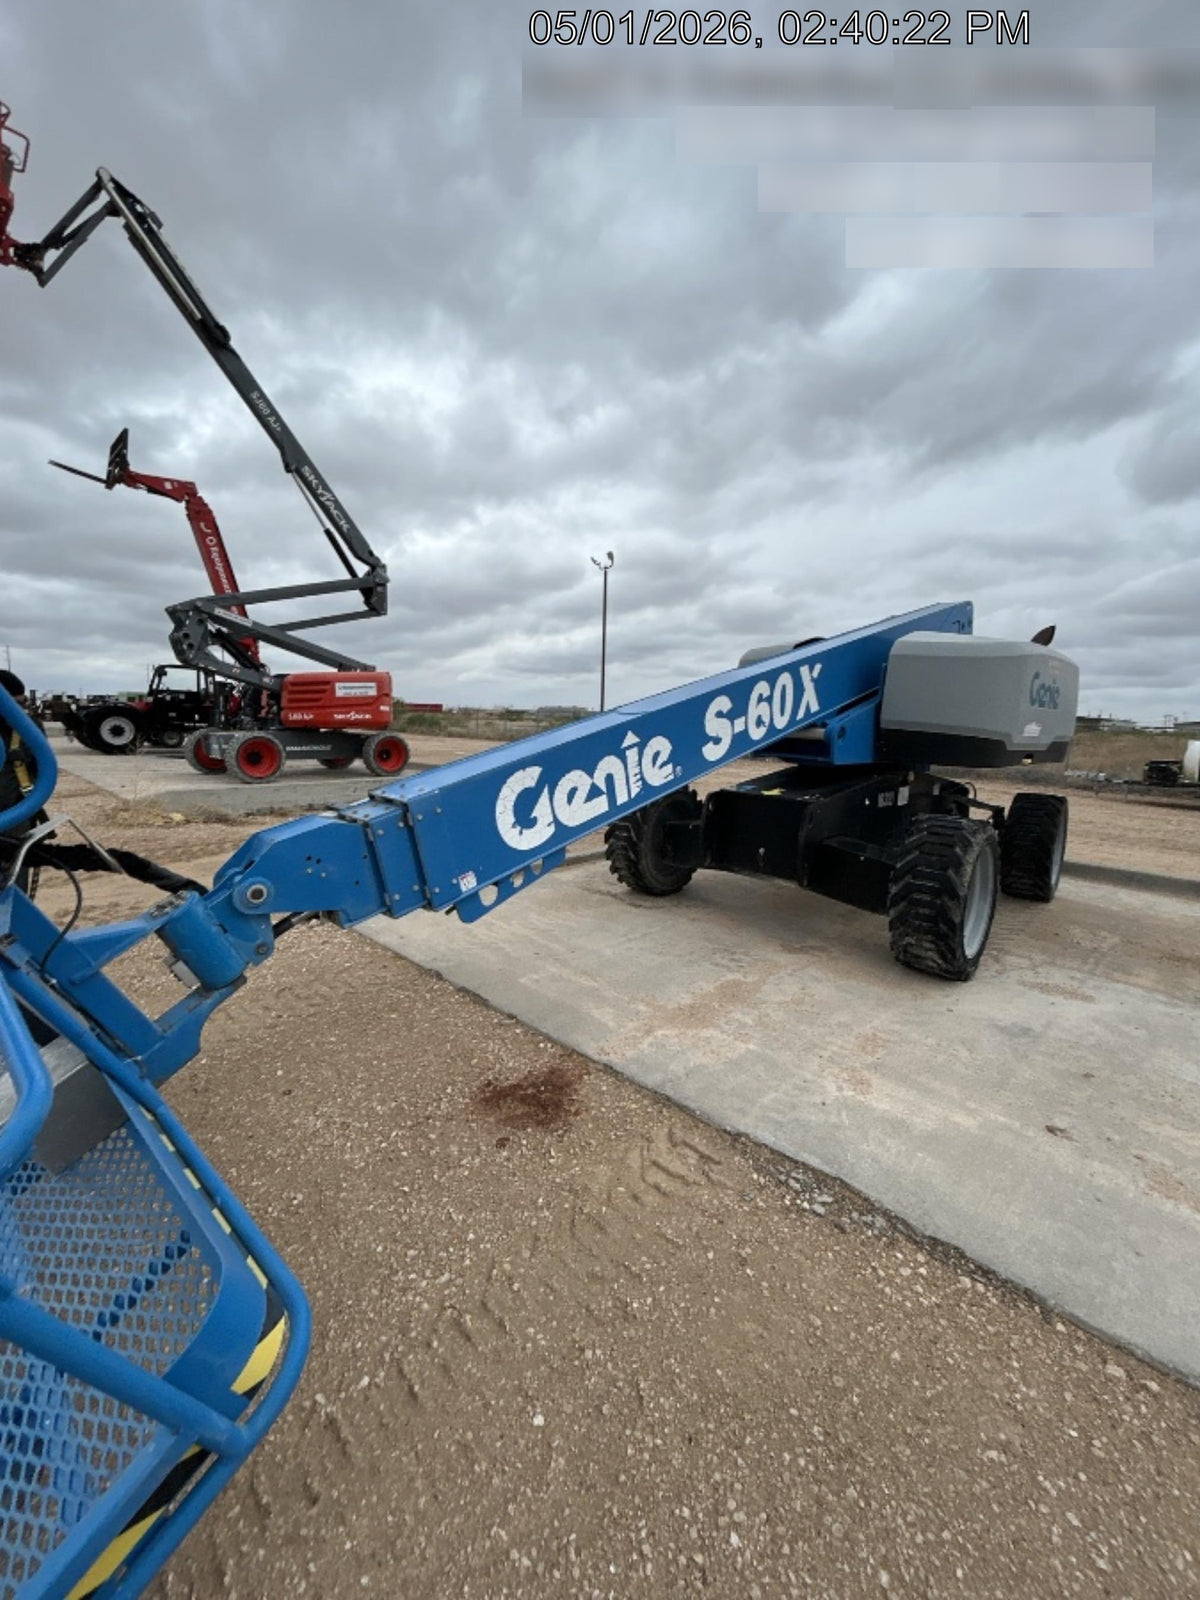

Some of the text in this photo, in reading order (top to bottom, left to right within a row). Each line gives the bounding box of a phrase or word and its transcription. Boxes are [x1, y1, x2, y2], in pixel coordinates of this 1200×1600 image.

[301, 465, 350, 533] SKYJACK
[702, 663, 822, 762] S-60X
[1029, 671, 1060, 709] Genie
[495, 731, 675, 851] Genie
